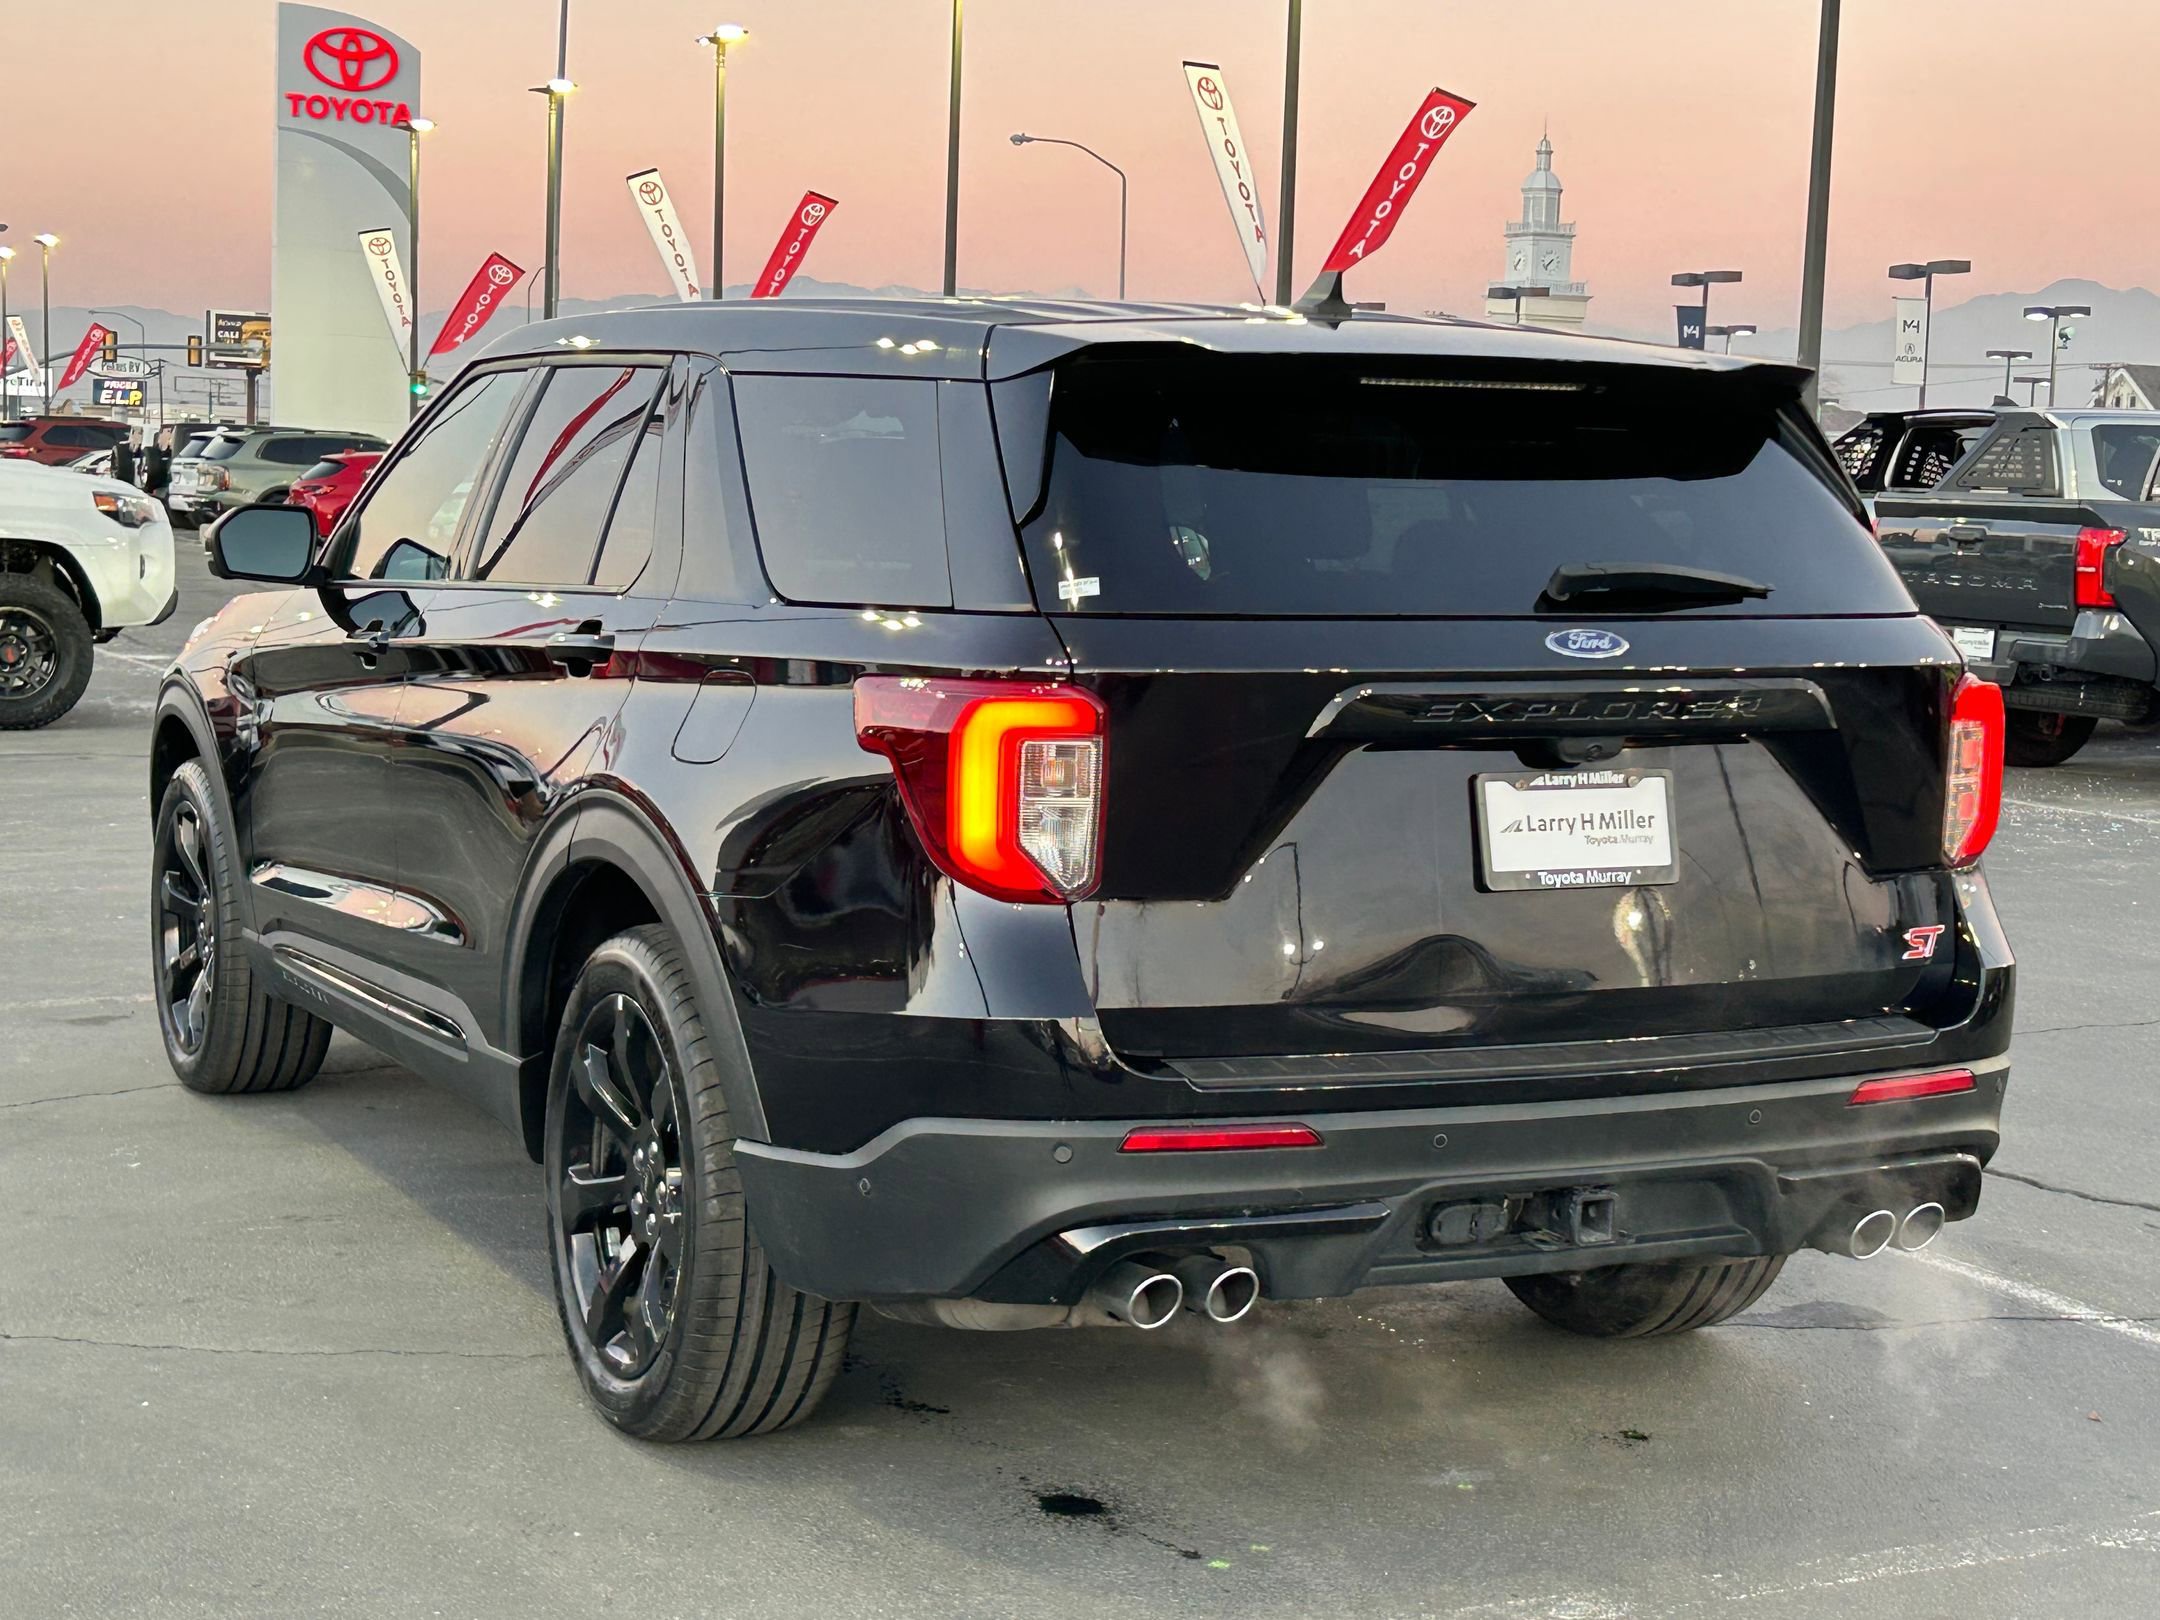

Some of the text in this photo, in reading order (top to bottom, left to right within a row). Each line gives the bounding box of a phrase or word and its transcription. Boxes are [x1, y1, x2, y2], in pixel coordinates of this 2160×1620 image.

[284, 91, 412, 128] TOYOTA
[1216, 116, 1265, 243] TOYOTA
[1348, 142, 1430, 259] TOYOTA
[655, 208, 700, 298] TOYOTA
[766, 228, 810, 299] TOYOT
[381, 257, 412, 328] TOYOTA
[453, 283, 498, 345] TOYOTA
[1895, 355, 1923, 363] ACURA
[1567, 632, 1613, 650] Ford
[1413, 697, 1763, 724] EXPLORER
[1544, 771, 1626, 788] Larry H Miller
[1526, 809, 1656, 836] Larry H Miller
[1584, 833, 1654, 847] Toyota Murray
[1537, 869, 1633, 888] Toyota Murray
[1901, 924, 1946, 960] ST
